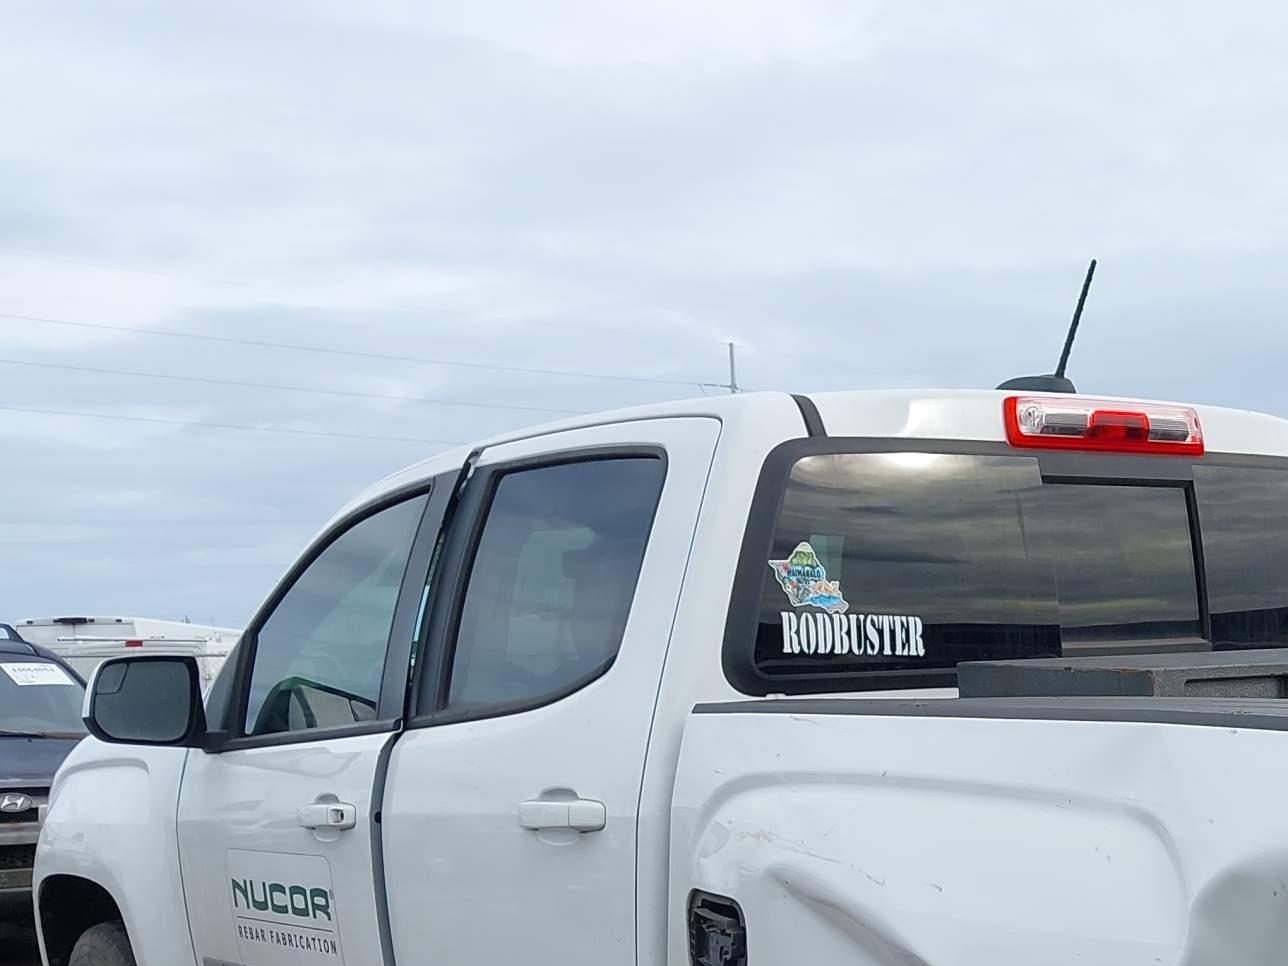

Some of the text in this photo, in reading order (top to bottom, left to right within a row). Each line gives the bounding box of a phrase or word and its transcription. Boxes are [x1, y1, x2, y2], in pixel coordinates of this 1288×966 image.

[780, 611, 926, 657] RODBUSTER
[231, 878, 332, 921] NUCOR
[238, 925, 337, 955] REBAR FABRICATION
